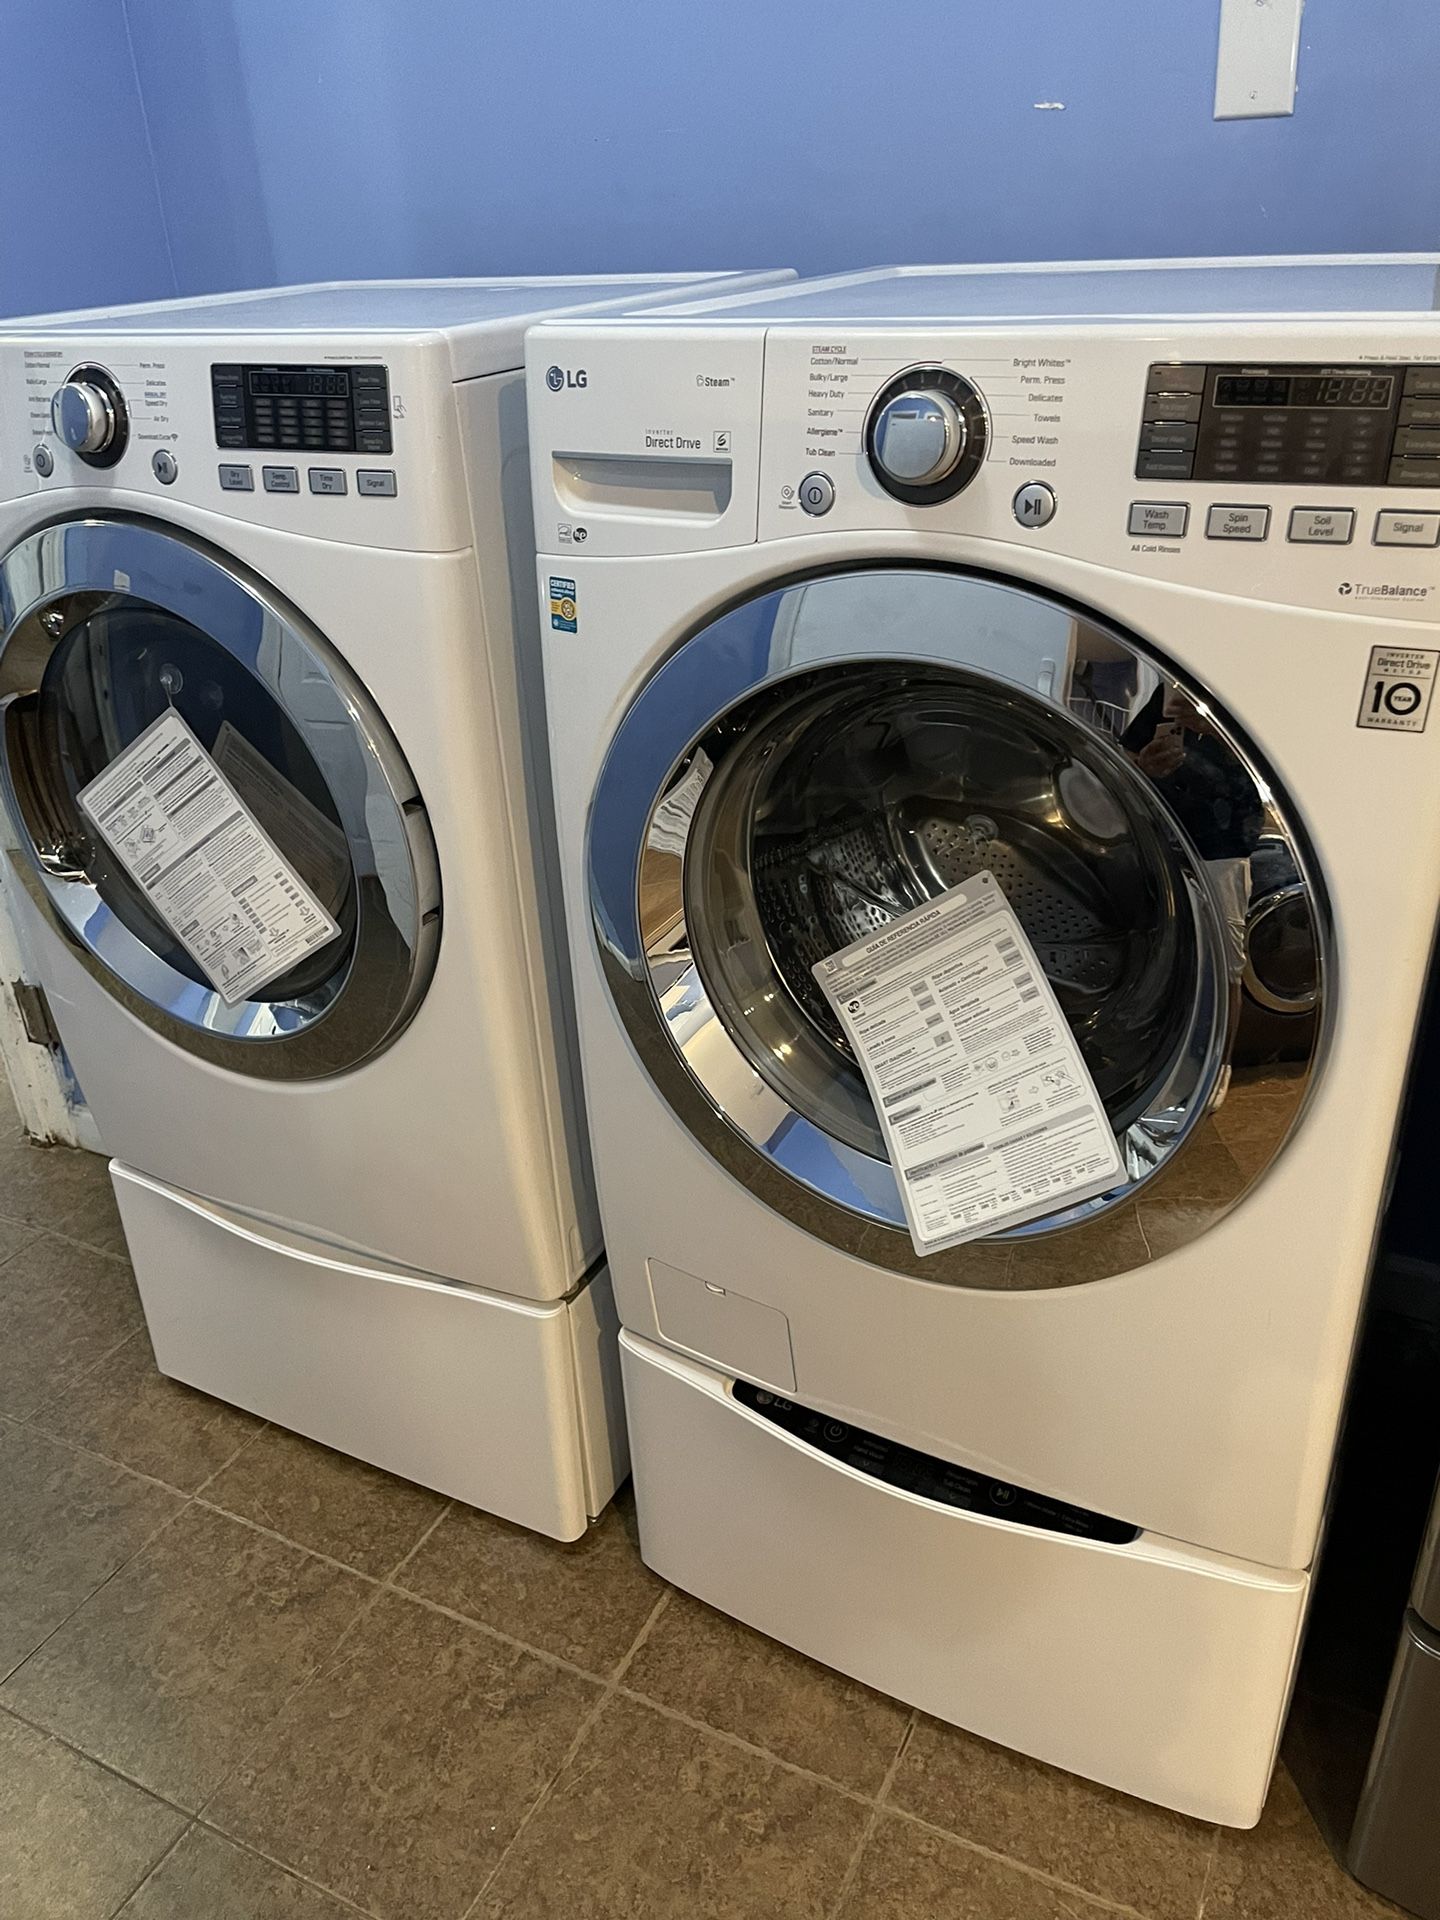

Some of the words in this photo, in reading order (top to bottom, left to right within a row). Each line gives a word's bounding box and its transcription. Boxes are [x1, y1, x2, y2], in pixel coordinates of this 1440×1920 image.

[812, 346, 830, 354] STEAM
[831, 346, 846, 354] CYCLE
[810, 357, 858, 365] Cotton/Normal
[1013, 358, 1036, 368] Bright
[567, 370, 587, 388] LG
[809, 373, 848, 383] Bulky/Large
[1020, 376, 1042, 384] Perm.
[1044, 376, 1066, 384] Press
[809, 390, 828, 398] Heavy
[829, 390, 845, 398] Duty
[1028, 394, 1063, 402] Delicates
[808, 409, 833, 417] Sanitary
[1034, 414, 1060, 422] Towels
[646, 436, 674, 448] Direct
[676, 437, 701, 449] Drive
[1012, 435, 1035, 444] Speed
[1037, 436, 1058, 444] Wash
[806, 448, 817, 456] Tub
[1009, 457, 1056, 466] Downloaded
[230, 471, 240, 480] Dry
[323, 482, 332, 490] Dry
[1145, 510, 1169, 518] Wash
[1228, 513, 1248, 524] Spin
[1314, 516, 1332, 525] Soil
[1223, 524, 1251, 534] Speed
[1308, 527, 1334, 536] Level
[1393, 522, 1424, 533] Signal
[1377, 657, 1405, 667] Direct
[1406, 660, 1430, 669] Drive
[1371, 681, 1422, 716] 10
[1367, 717, 1417, 726] WARRANTY
[866, 943, 879, 953] GUÍA
[879, 939, 887, 947] DE
[887, 922, 920, 944] REFERENCIA
[920, 910, 940, 924] RÁPIDA
[774, 1398, 792, 1411] LG
